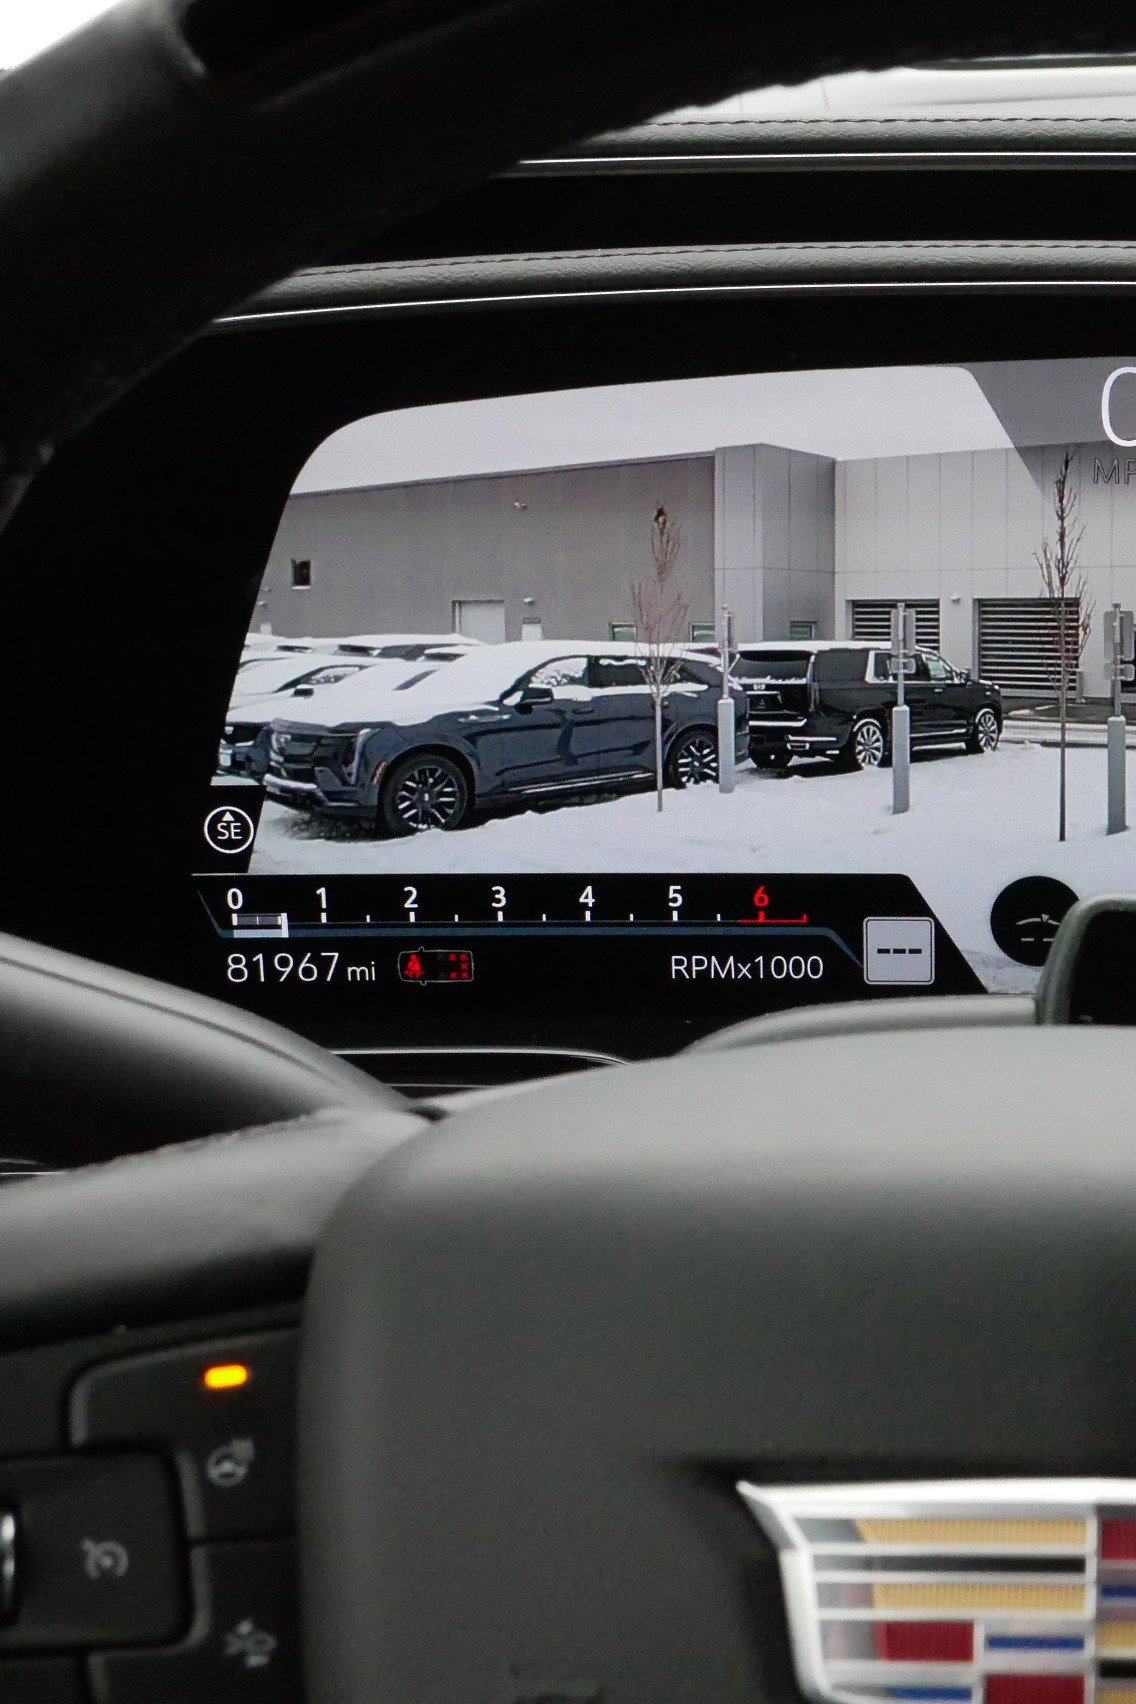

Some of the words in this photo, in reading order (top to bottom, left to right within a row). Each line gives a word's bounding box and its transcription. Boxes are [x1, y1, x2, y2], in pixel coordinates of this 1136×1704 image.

[216, 822, 243, 840] SE
[226, 887, 244, 910] 0
[315, 886, 328, 909] 1
[403, 886, 420, 909] 2
[491, 885, 508, 908] 3
[578, 885, 596, 908] 4
[668, 885, 684, 908] 5
[753, 885, 769, 908] 6
[670, 954, 824, 979] RPMx1000
